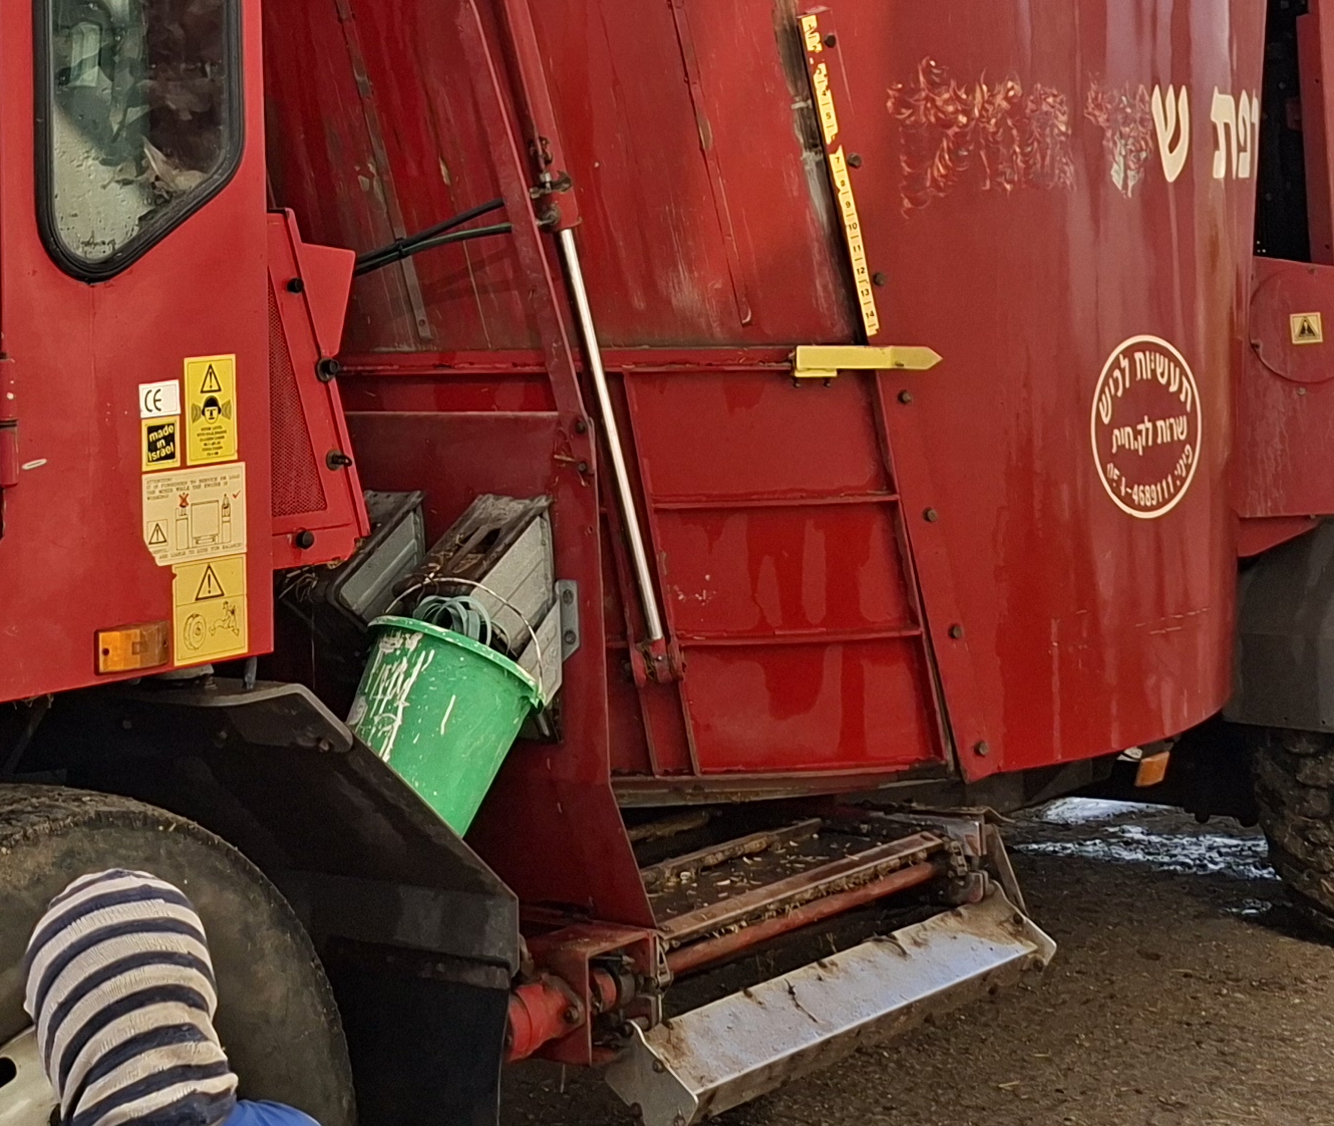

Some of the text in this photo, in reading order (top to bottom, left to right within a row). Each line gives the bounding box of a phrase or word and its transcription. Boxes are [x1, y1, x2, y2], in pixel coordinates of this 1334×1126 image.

[848, 222, 858, 231] 10
[856, 266, 865, 275] 12
[865, 310, 875, 319] 14
[1098, 350, 1192, 424] תעשיות לכיש
[144, 388, 163, 412] CE
[149, 425, 174, 442] made
[1155, 414, 1187, 445] שרות
[148, 442, 174, 461] Israel
[156, 439, 166, 448] in
